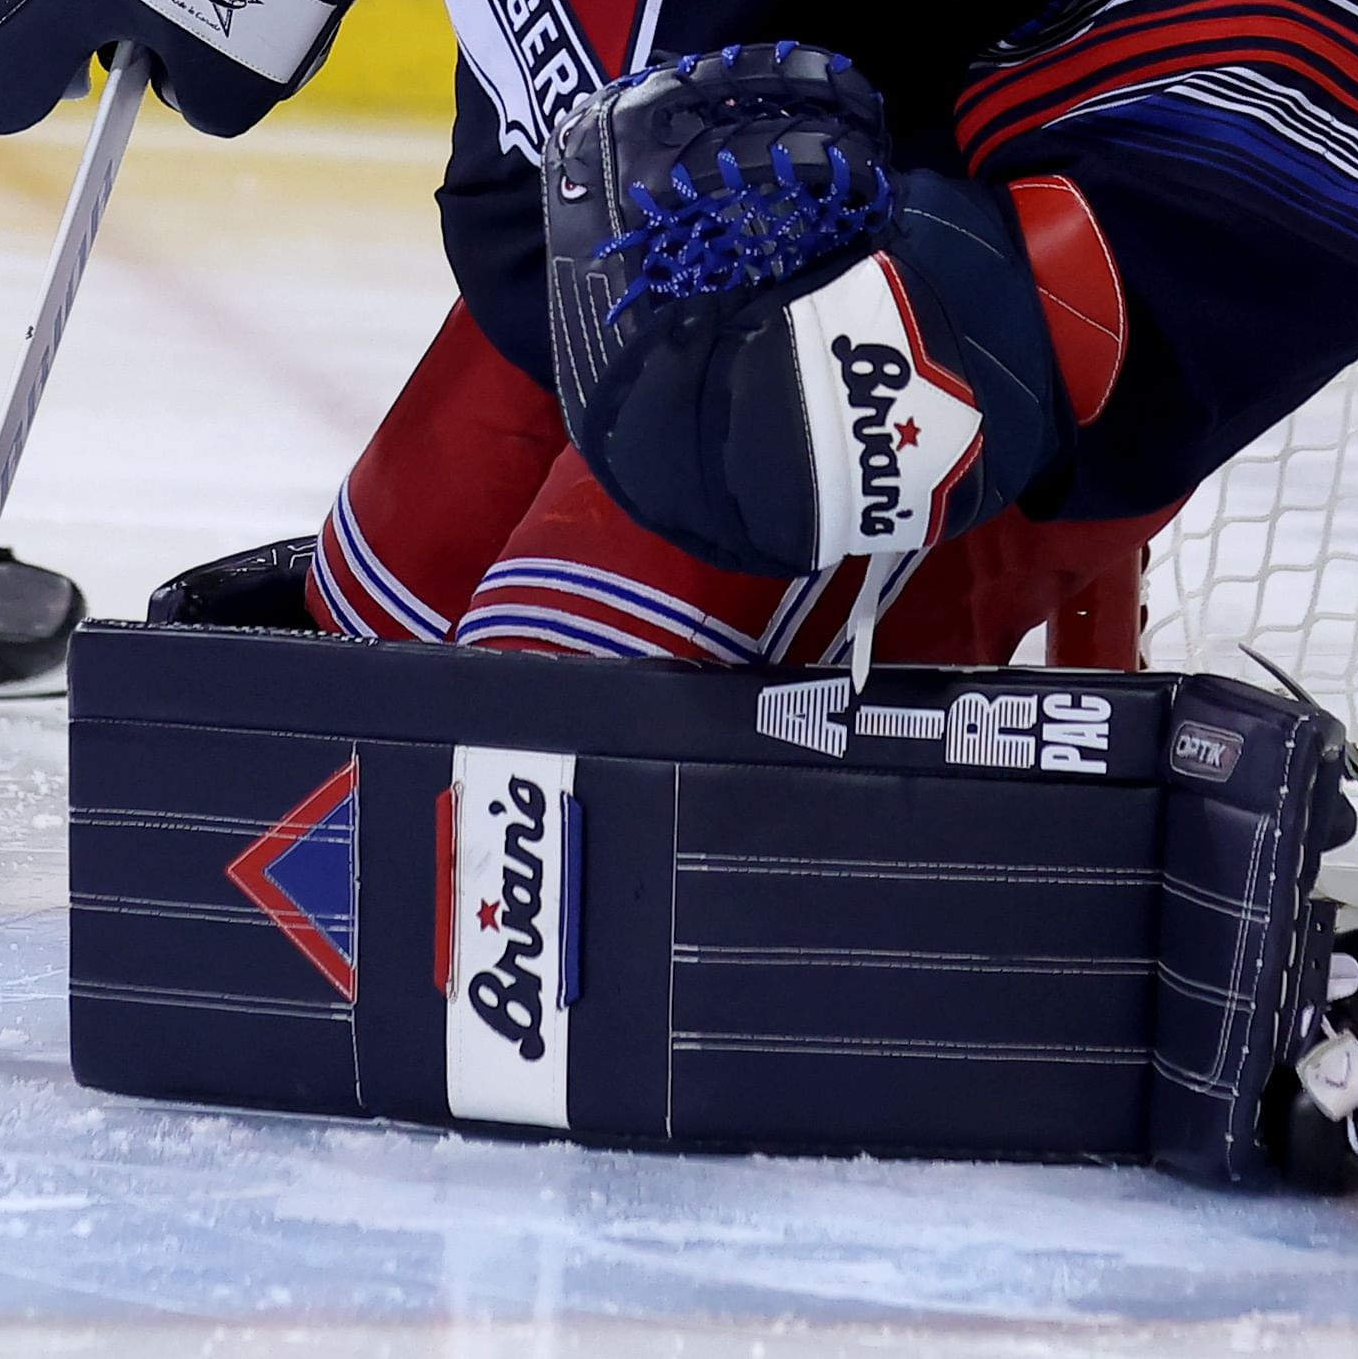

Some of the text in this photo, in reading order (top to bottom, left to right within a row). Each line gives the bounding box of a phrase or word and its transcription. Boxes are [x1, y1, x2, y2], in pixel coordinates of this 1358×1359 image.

[831, 334, 913, 537] Brian's
[756, 677, 1039, 769] AIR
[1041, 693, 1112, 774] PAC
[468, 774, 547, 1061] Brian's
